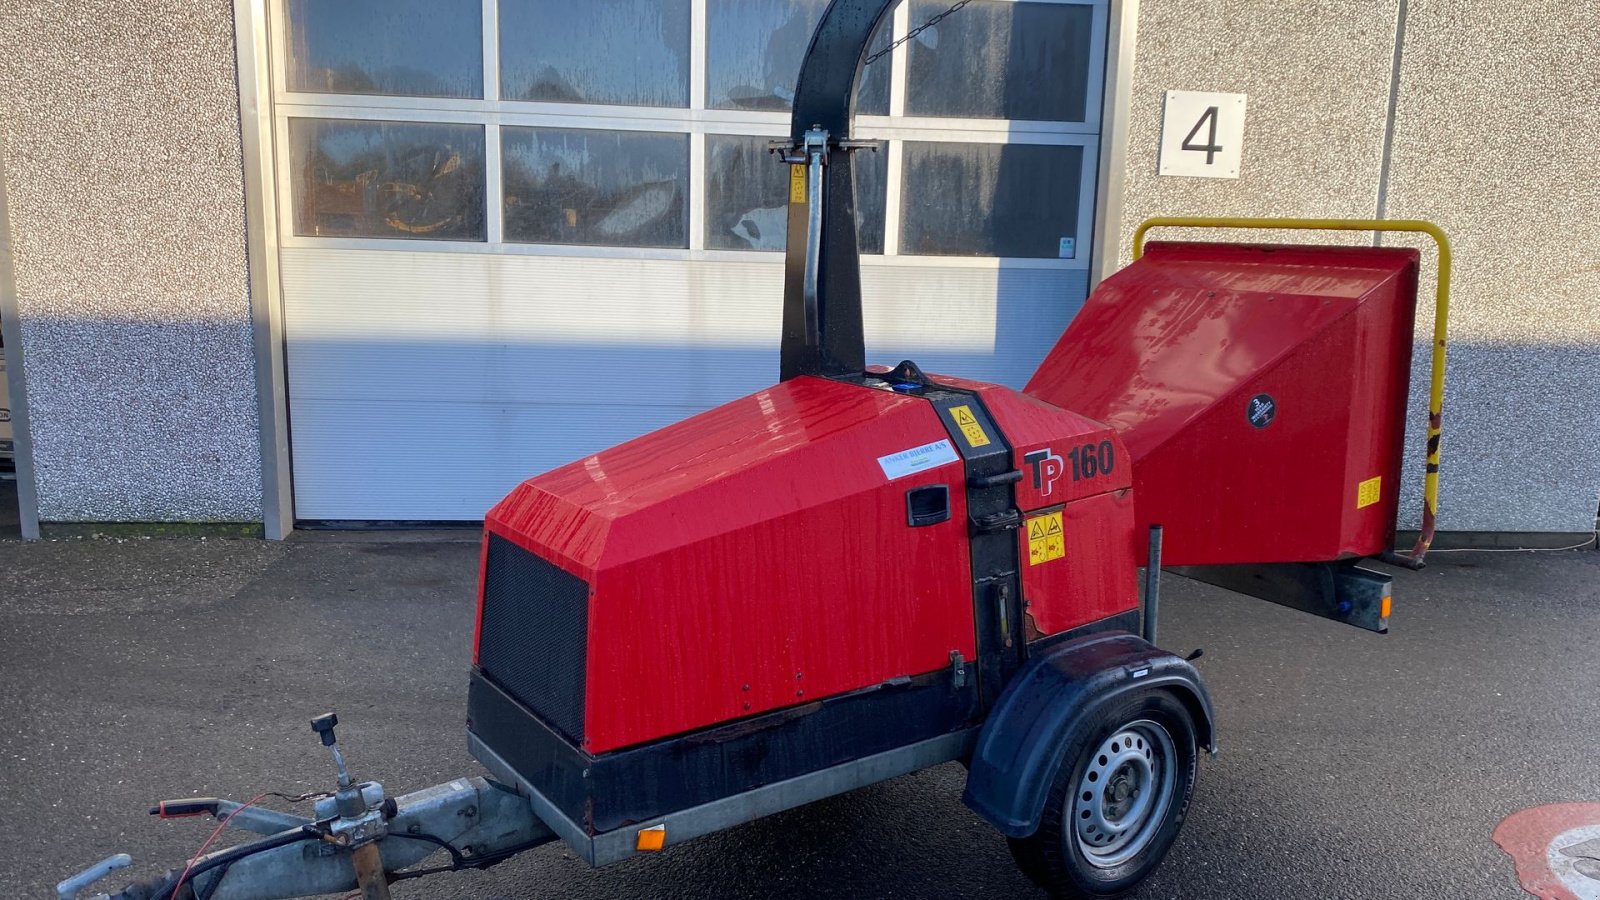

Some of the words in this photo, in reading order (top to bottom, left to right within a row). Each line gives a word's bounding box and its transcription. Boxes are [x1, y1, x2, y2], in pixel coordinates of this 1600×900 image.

[1181, 106, 1223, 165] 4
[1024, 448, 1064, 496] TP
[1067, 440, 1114, 481] 160
